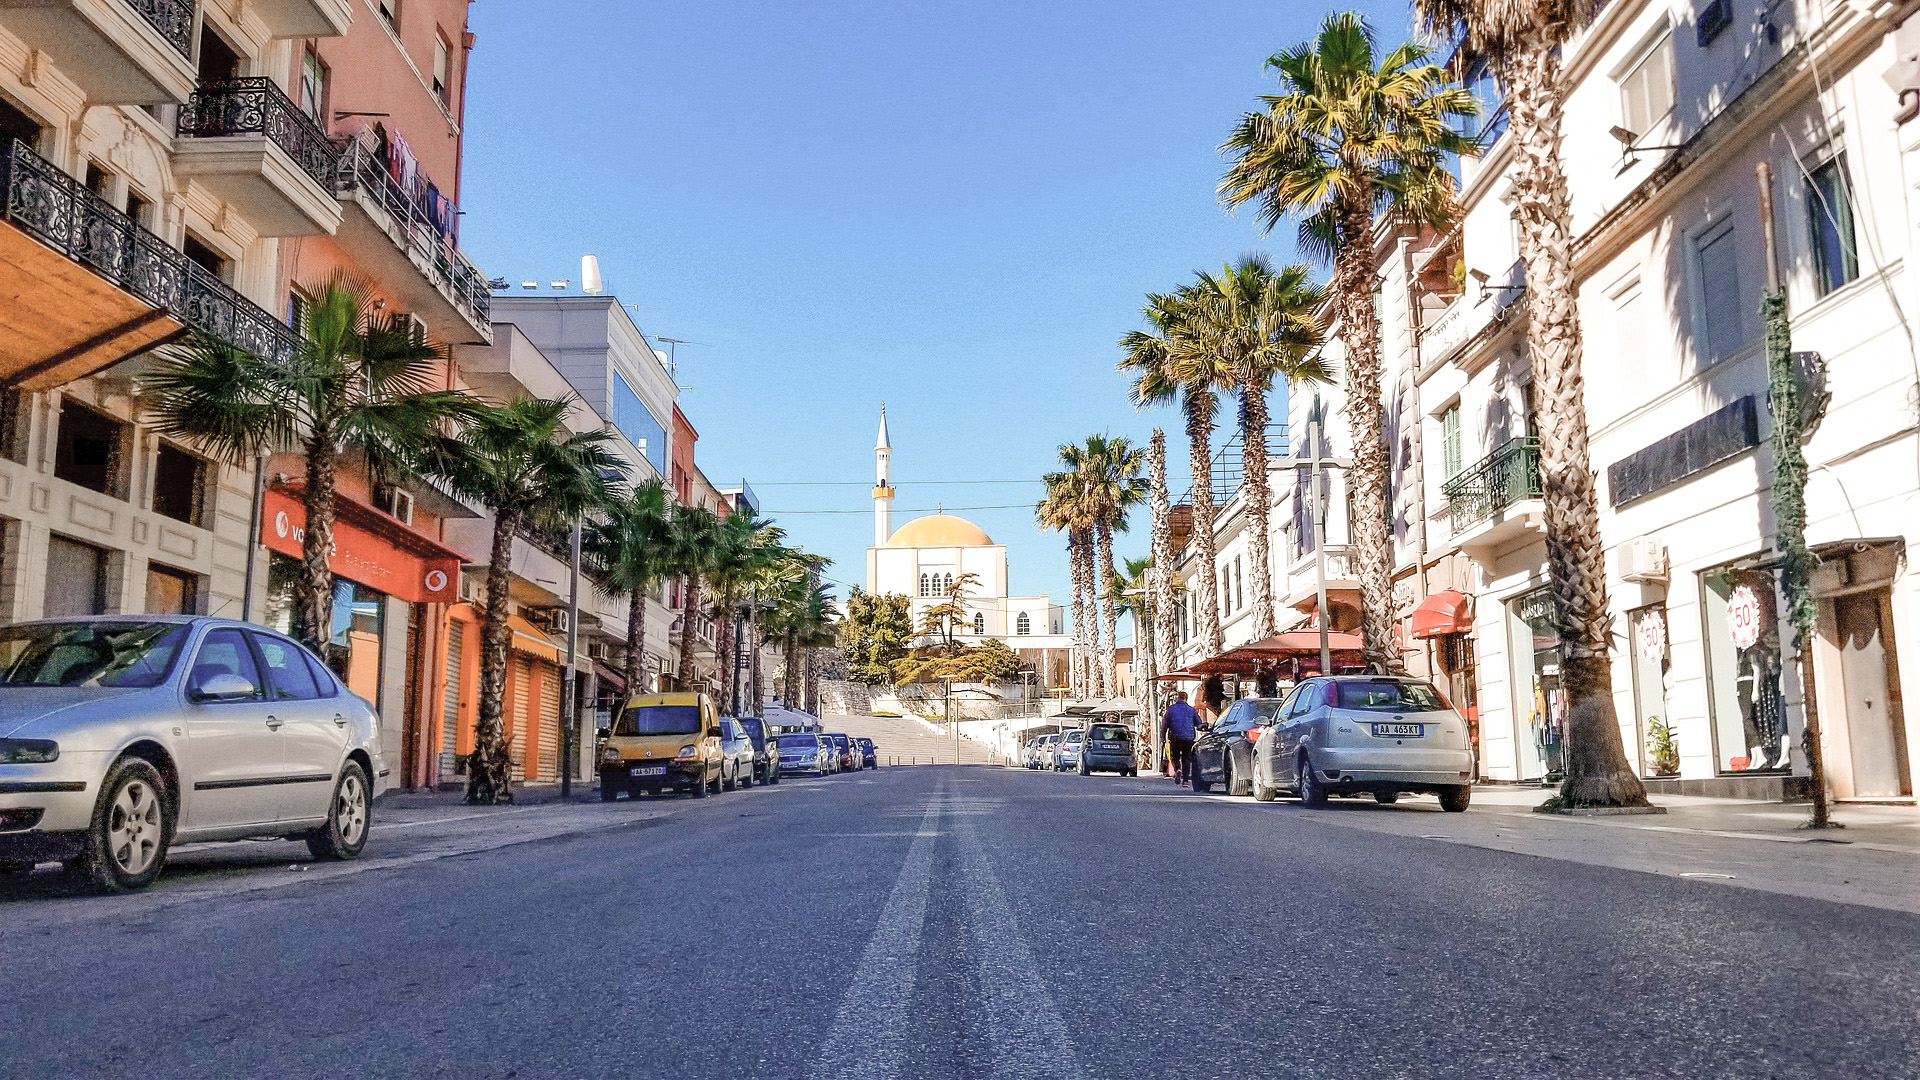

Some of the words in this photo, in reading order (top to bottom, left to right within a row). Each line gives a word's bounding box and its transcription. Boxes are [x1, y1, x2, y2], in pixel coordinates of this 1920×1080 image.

[1735, 604, 1750, 628] 50
[1646, 626, 1658, 647] 50
[1380, 725, 1390, 734] AA
